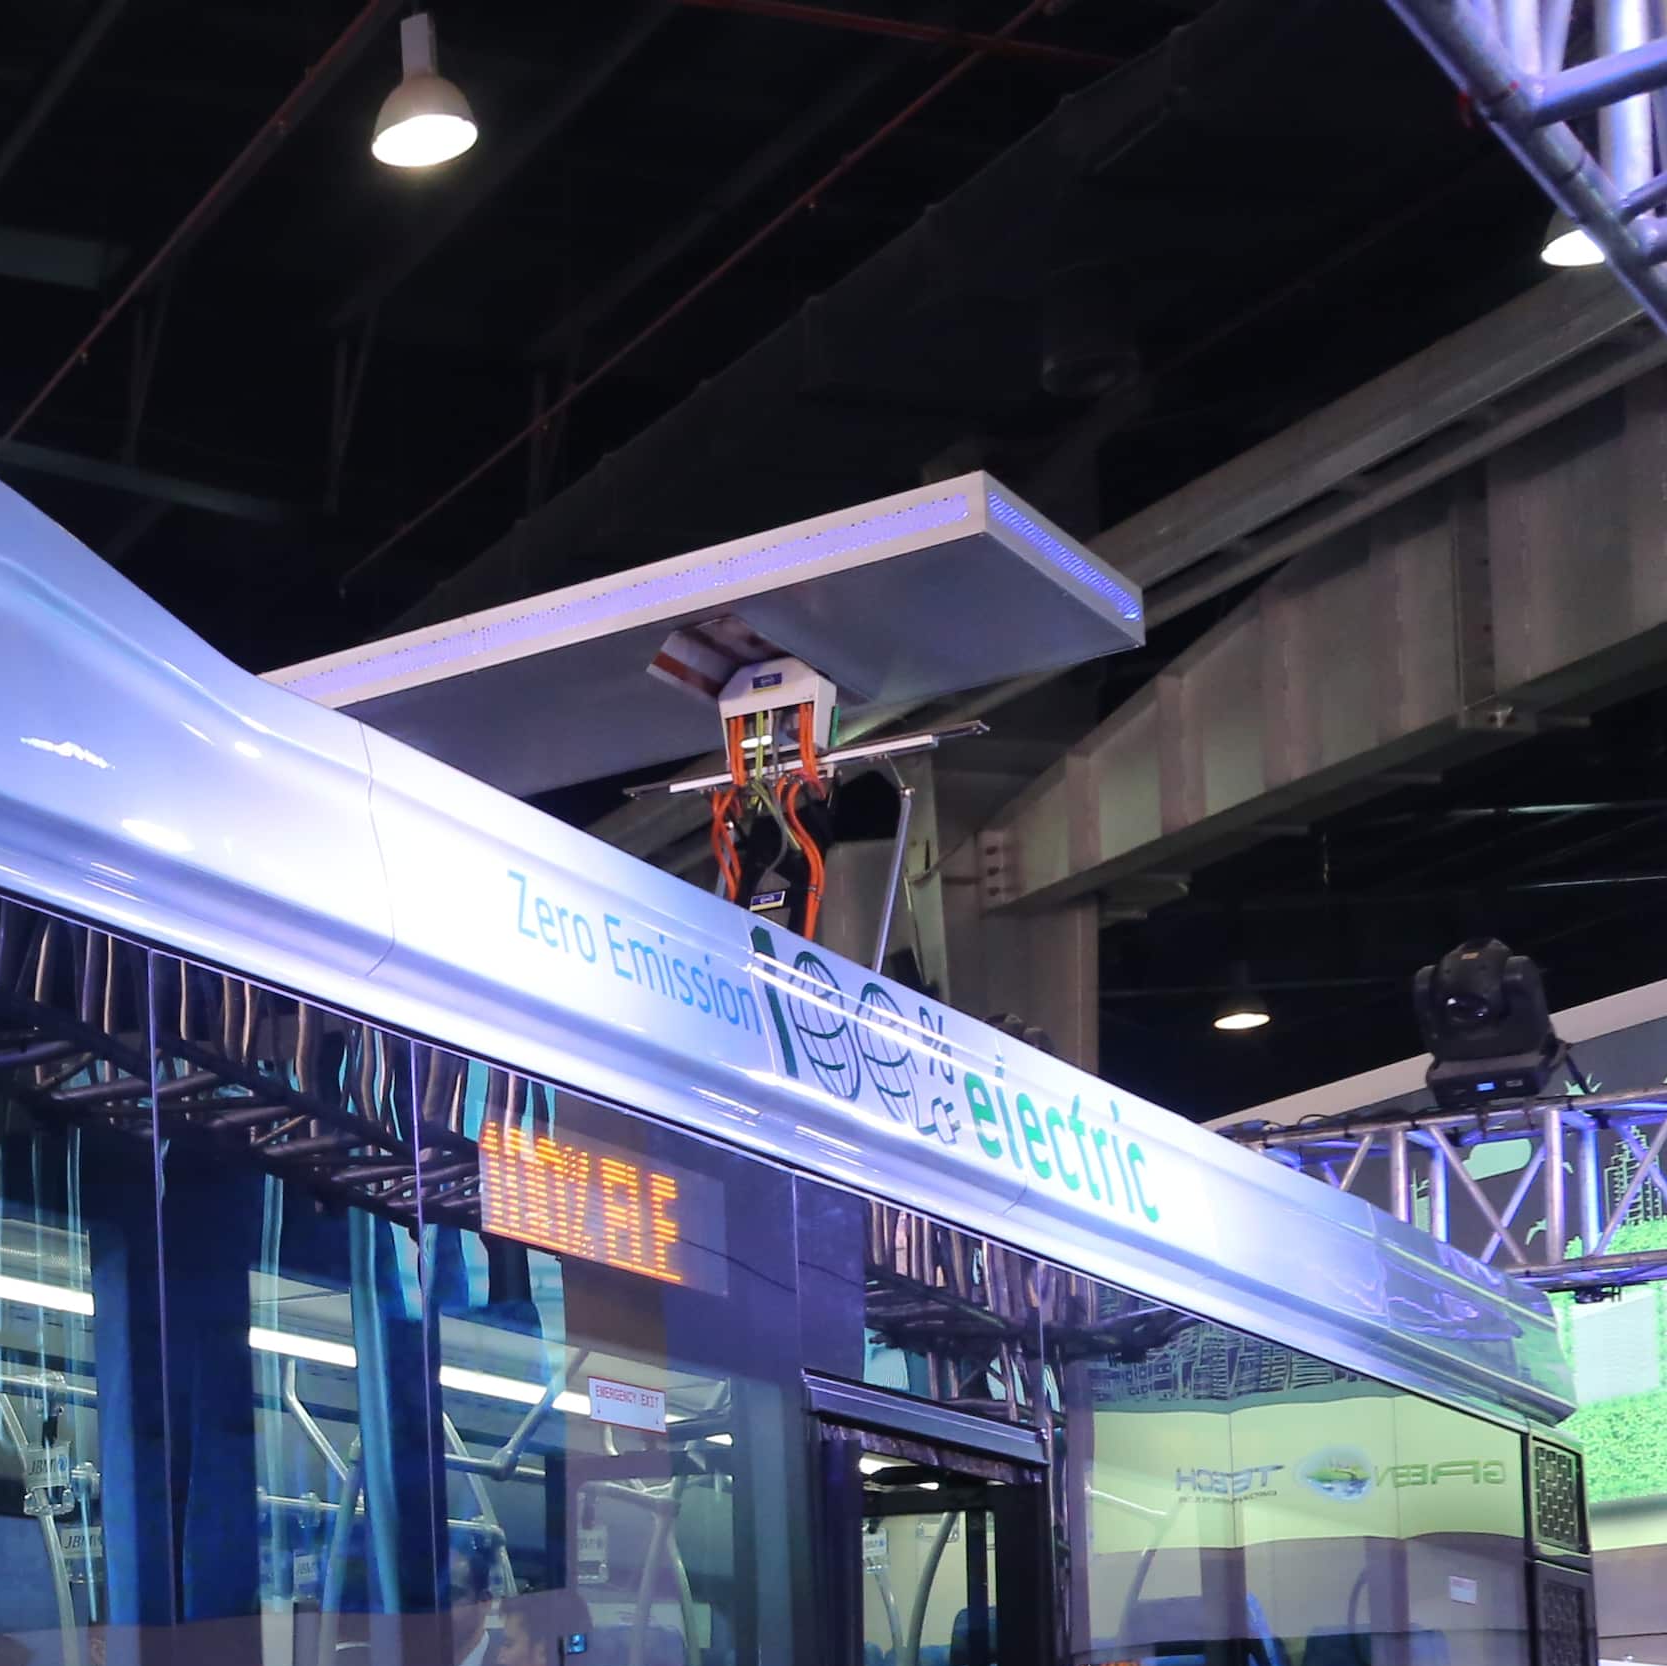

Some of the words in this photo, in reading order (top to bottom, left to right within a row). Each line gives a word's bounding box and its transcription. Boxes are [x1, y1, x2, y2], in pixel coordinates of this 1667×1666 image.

[508, 869, 597, 964] Zero
[604, 912, 762, 1035] Emission
[965, 1054, 1160, 1223] electric
[641, 1393, 659, 1408] EXIT
